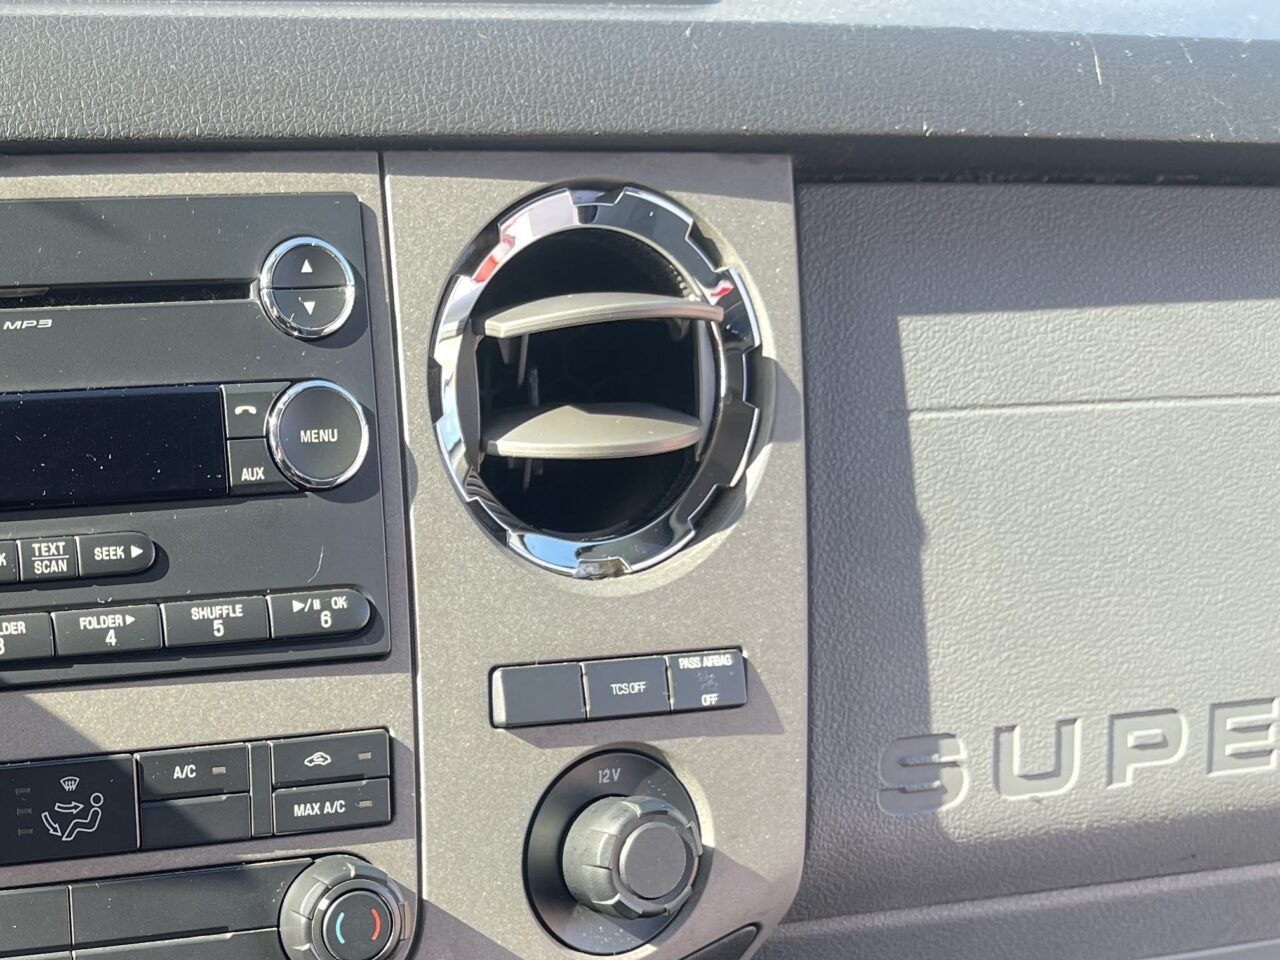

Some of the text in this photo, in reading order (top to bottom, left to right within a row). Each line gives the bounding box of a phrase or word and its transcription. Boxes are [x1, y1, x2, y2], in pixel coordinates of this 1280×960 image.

[3, 318, 53, 330] MP3
[300, 428, 338, 443] MENU
[241, 467, 265, 481] AUX
[32, 542, 66, 556] TEXT
[94, 545, 125, 561] SEEK
[34, 559, 68, 574] SCAN
[331, 595, 348, 609] OK
[190, 603, 243, 621] SHUFFLE
[320, 610, 332, 628] 6
[79, 614, 123, 630] FOLDER
[213, 619, 224, 637] 5
[105, 628, 117, 647] 4
[610, 681, 646, 695] TCS OFF
[701, 693, 719, 706] OFF
[877, 697, 1280, 817] SUPE
[173, 764, 197, 780] A/C
[293, 799, 346, 817] MAX A/C
